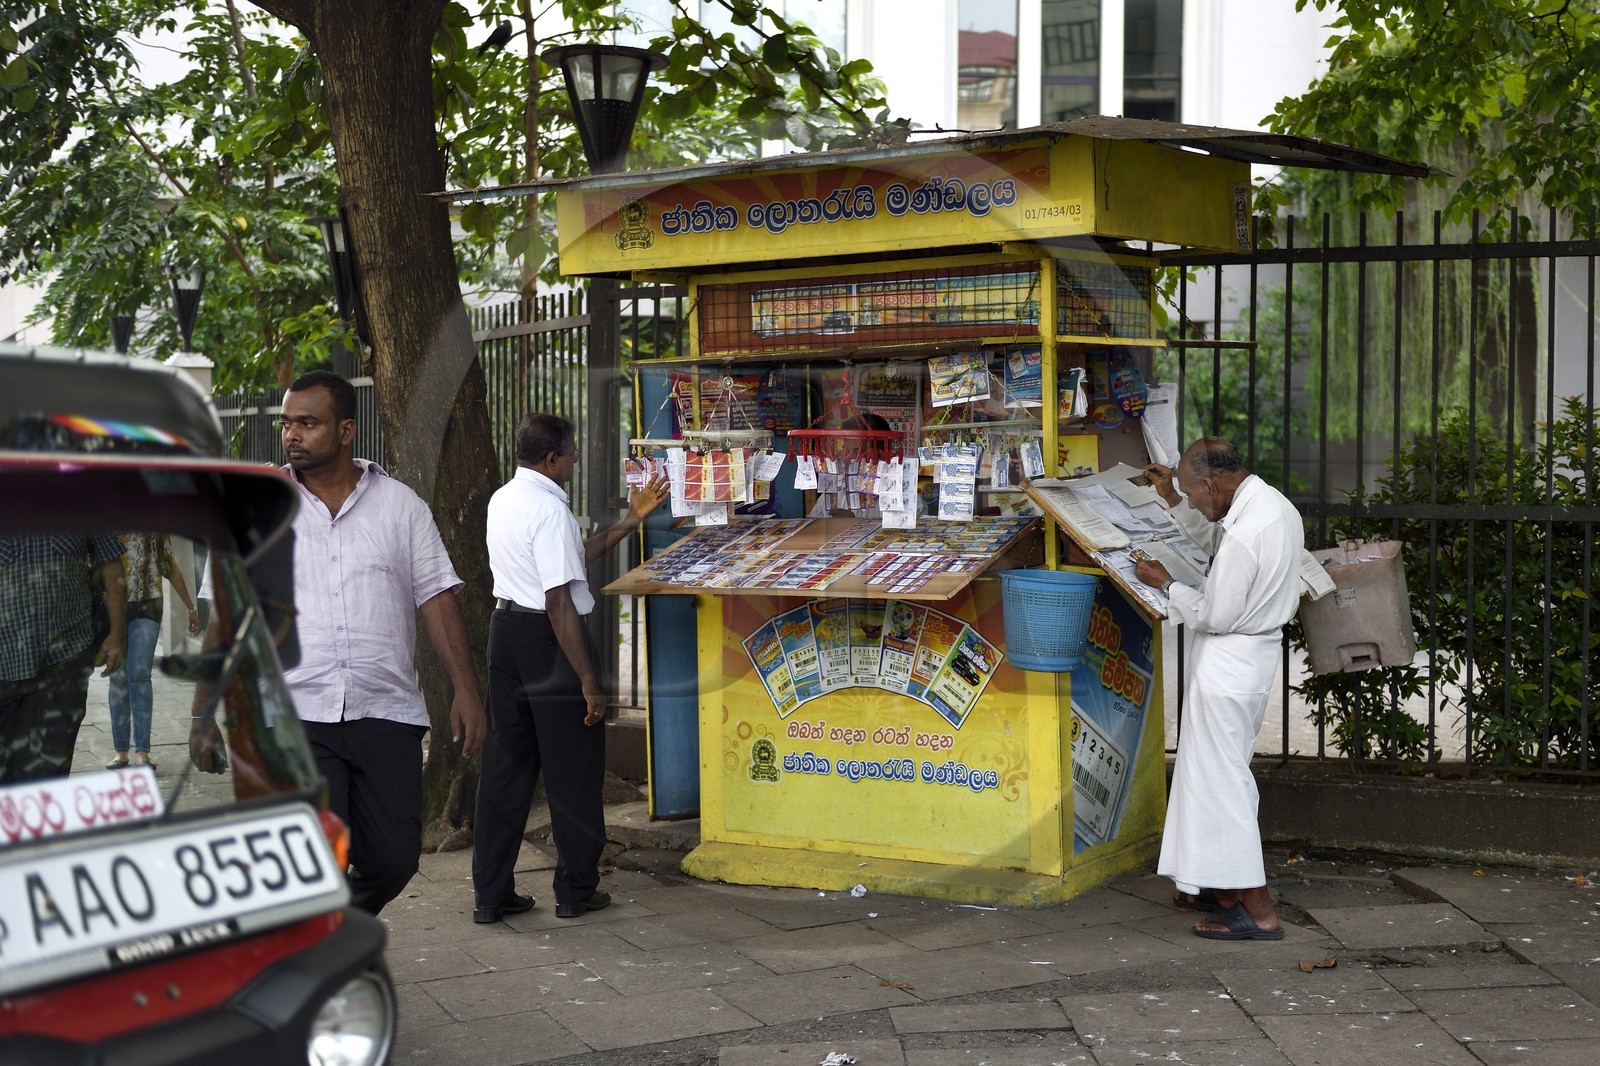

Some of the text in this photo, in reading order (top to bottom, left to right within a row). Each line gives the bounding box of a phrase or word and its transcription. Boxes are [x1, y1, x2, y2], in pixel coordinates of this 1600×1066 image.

[661, 176, 1017, 236] ජාතික ලොතරැයි මණ්ඩලය
[1025, 204, 1081, 221] 01/7434/03
[787, 720, 955, 752] ඔබත් හදන රටත් හදන
[1082, 732, 1088, 744] 1
[1089, 739, 1097, 753] 2
[1098, 747, 1105, 760] 3
[1106, 755, 1113, 768] 4
[1114, 762, 1121, 775] 5
[783, 750, 999, 792] ජාතික ලොතරැයි මණ්ඩලය
[25, 854, 156, 946] AAO
[174, 824, 325, 909] 8550
